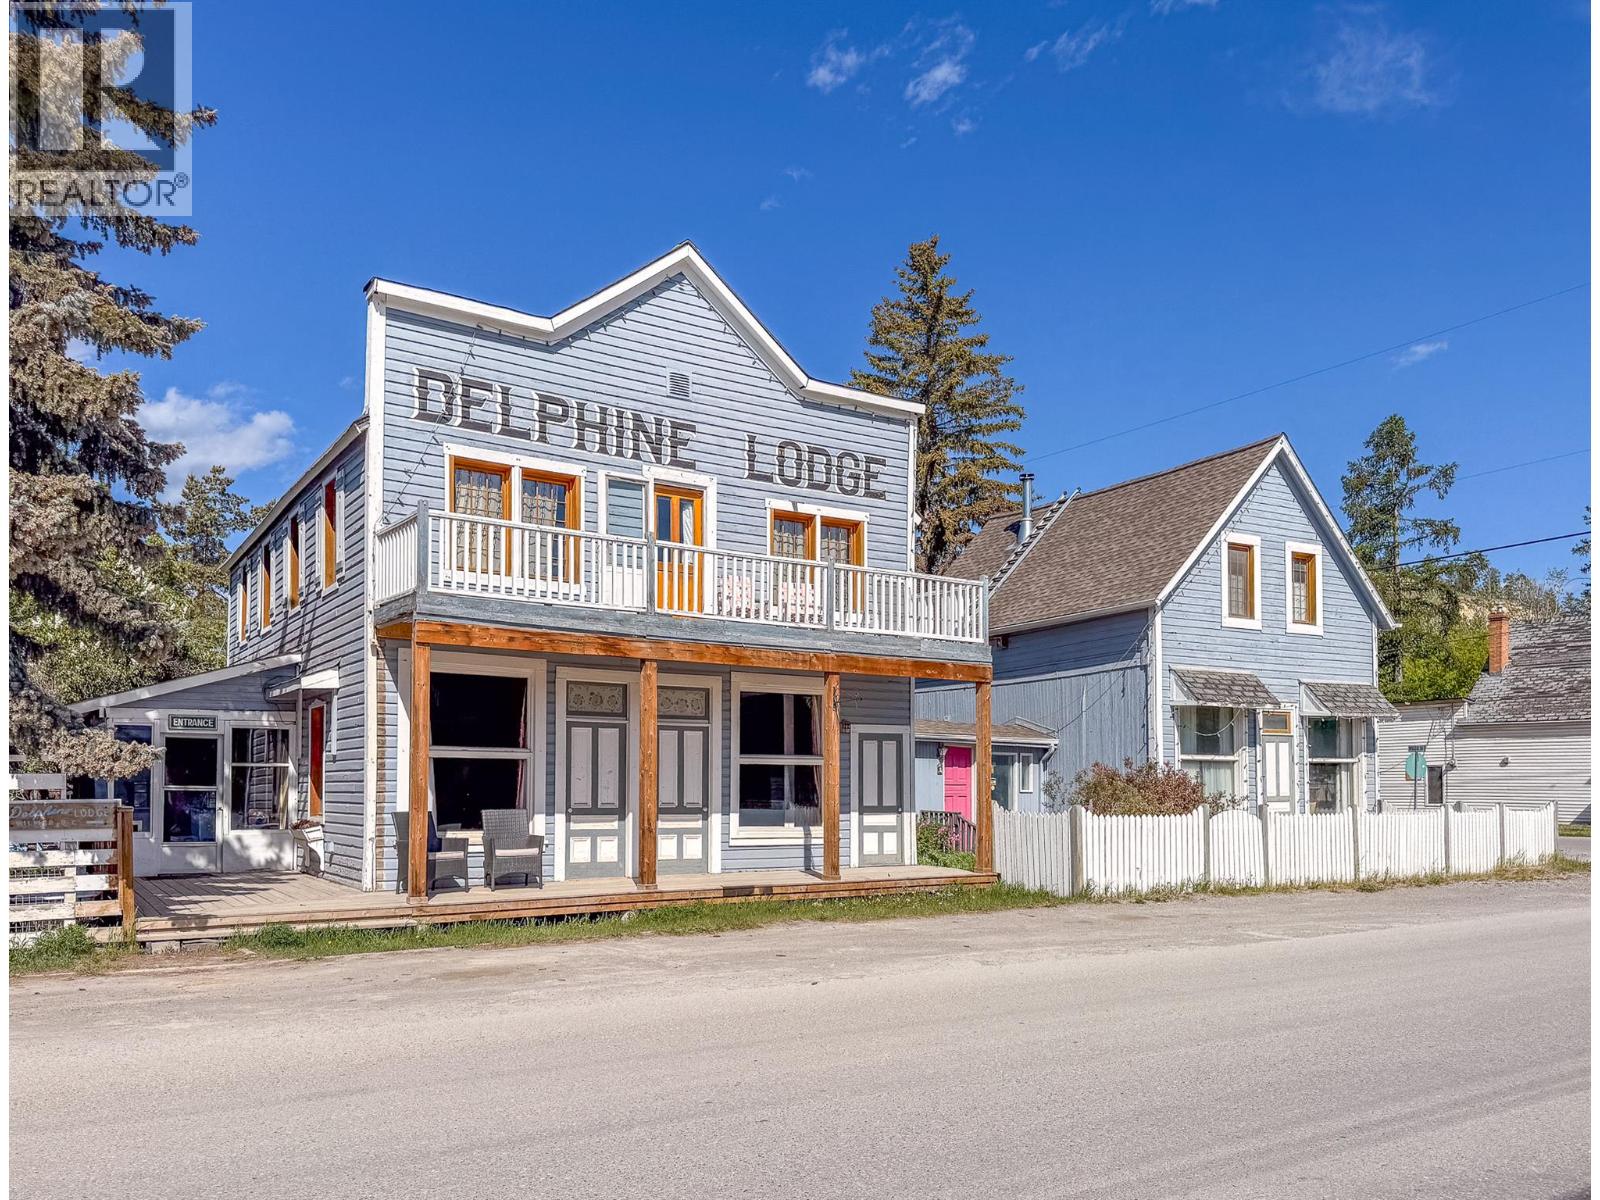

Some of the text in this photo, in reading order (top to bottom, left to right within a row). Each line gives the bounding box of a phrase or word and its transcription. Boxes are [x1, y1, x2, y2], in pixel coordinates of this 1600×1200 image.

[409, 367, 887, 500] DELPHINE LODGE
[173, 718, 214, 727] ENTRANCE
[74, 807, 109, 818] LODGE
